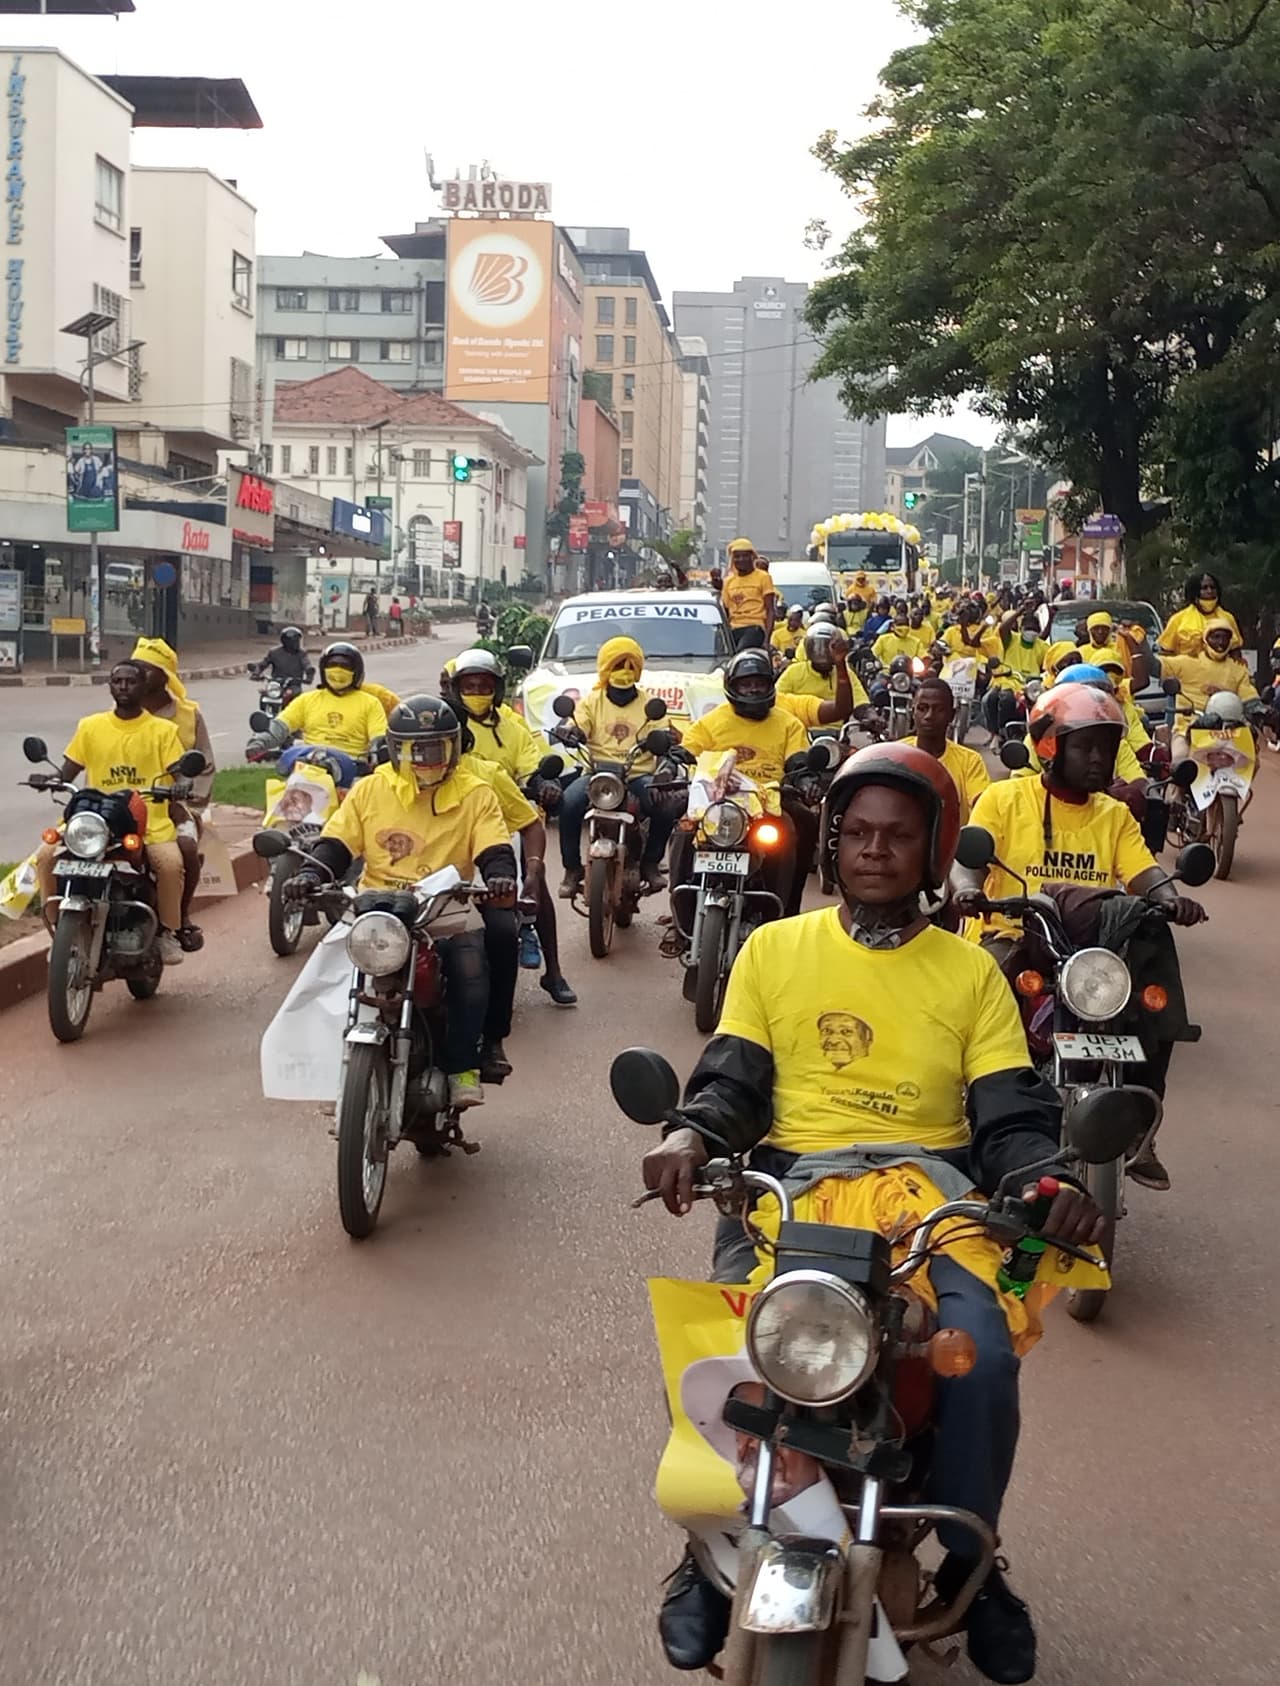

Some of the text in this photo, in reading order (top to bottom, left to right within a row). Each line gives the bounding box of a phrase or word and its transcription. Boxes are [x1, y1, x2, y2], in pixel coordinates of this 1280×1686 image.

[446, 182, 548, 209] BARODA
[5, 55, 26, 364] INSURANCE HOUSE
[182, 521, 209, 551] Bata
[576, 606, 699, 621] PEACE VAN
[715, 852, 743, 862] UEY
[1043, 850, 1095, 870] NRM
[707, 861, 742, 873] 560L
[1026, 866, 1109, 883] POLLING AGENT
[1086, 1034, 1128, 1046] UEP
[1081, 1046, 1136, 1060] 113M
